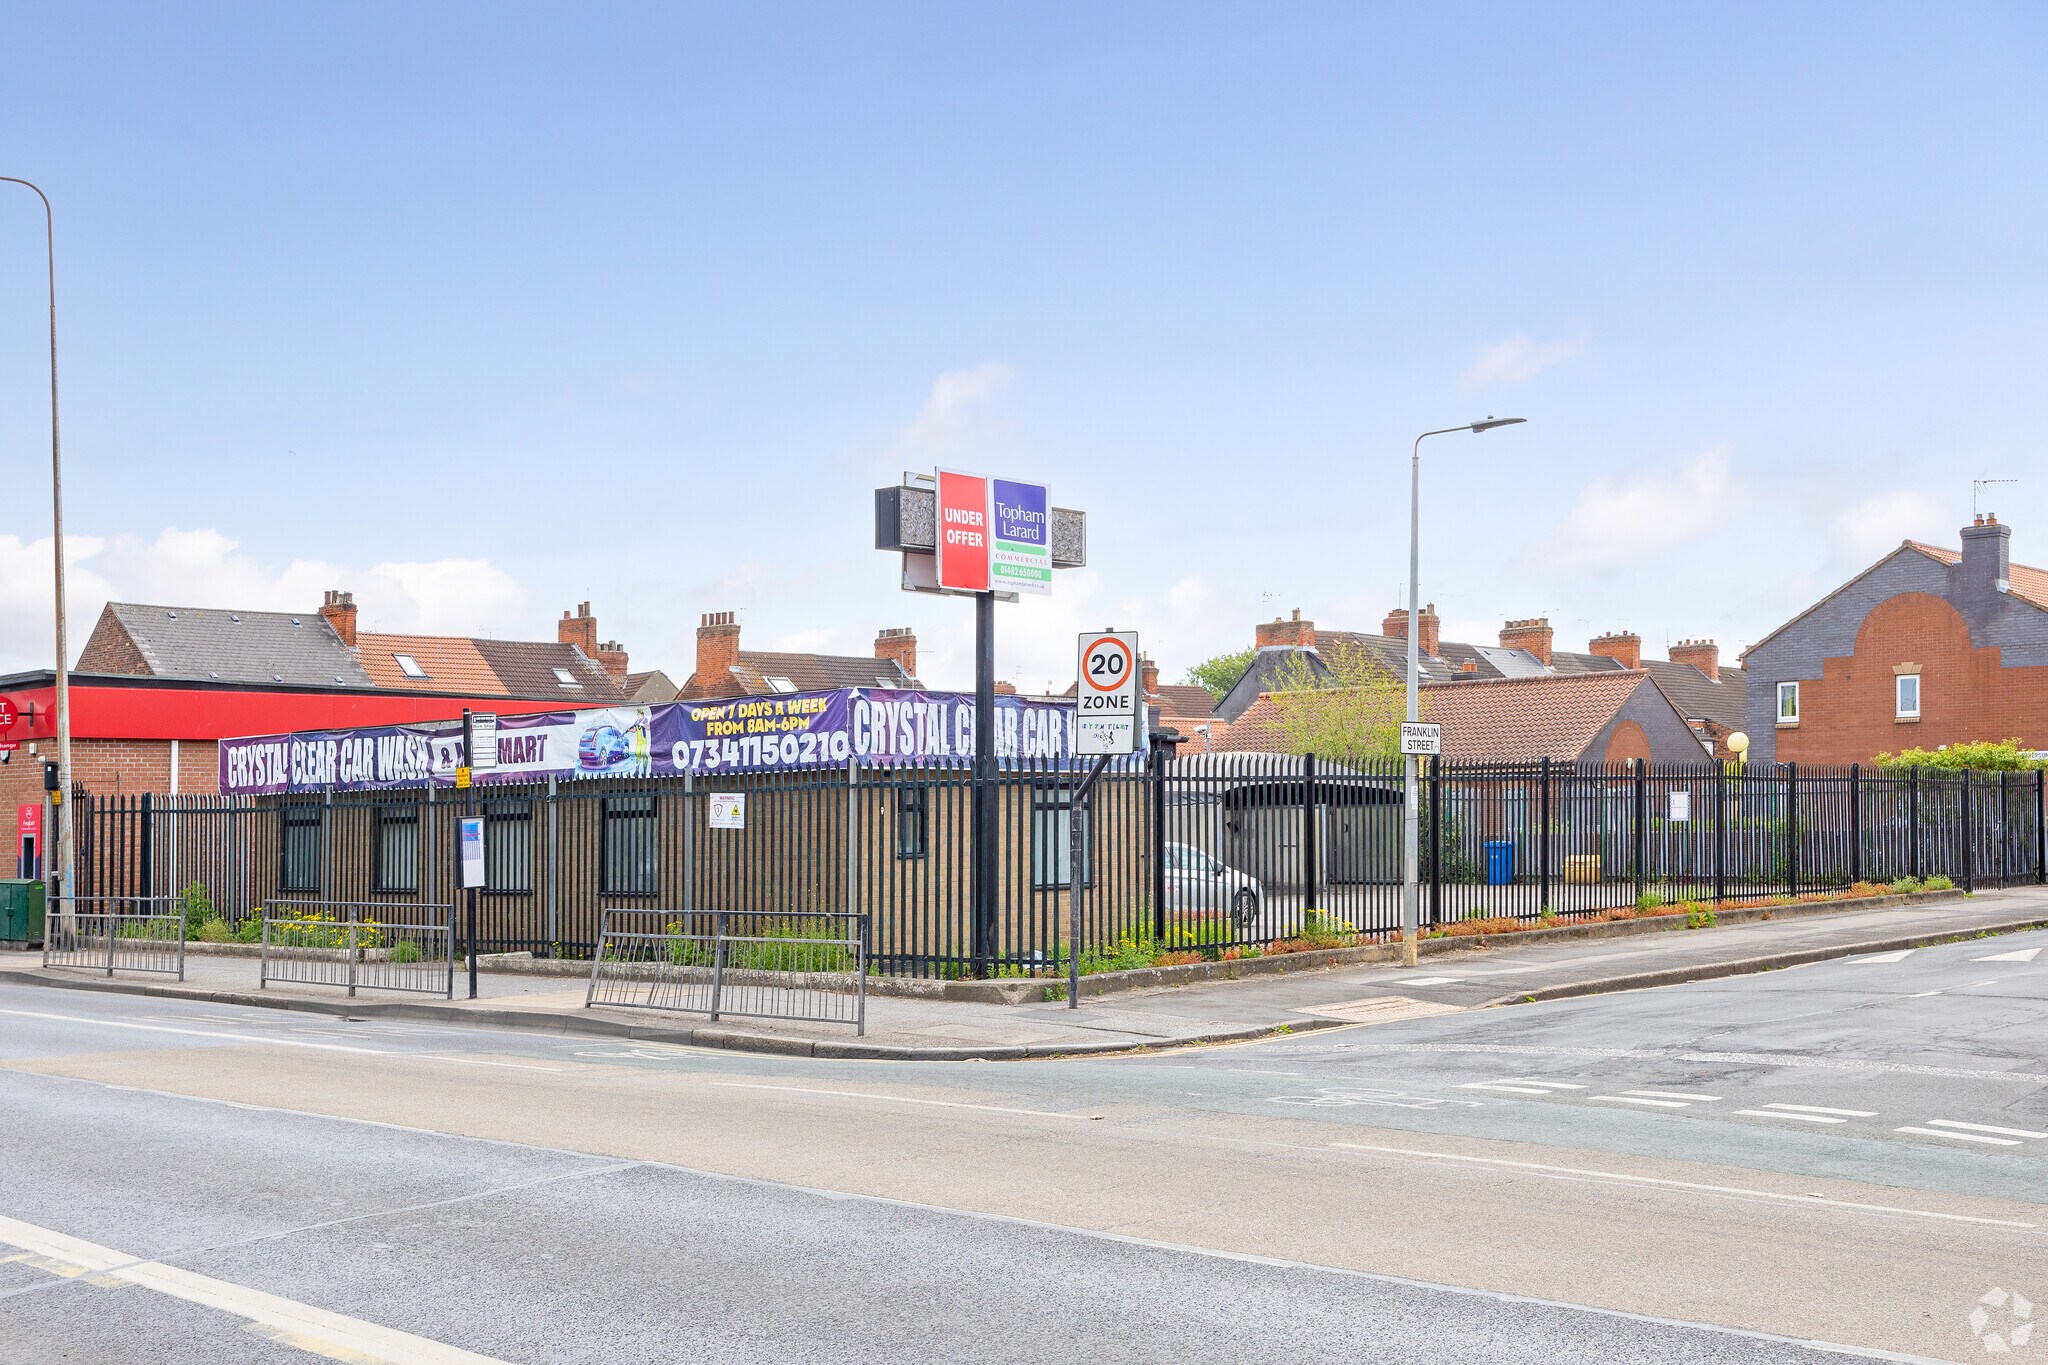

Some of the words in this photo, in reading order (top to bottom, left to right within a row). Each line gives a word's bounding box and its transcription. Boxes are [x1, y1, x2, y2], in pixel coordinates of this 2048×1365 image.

[945, 508, 983, 526] UNDER
[996, 502, 1044, 524] Topham
[947, 529, 983, 547] OFFER
[1003, 521, 1039, 540] Larard
[995, 553, 1048, 566] COMMERCIAL
[1000, 565, 1018, 576] 01482
[1019, 567, 1042, 579] 650000
[1091, 653, 1124, 675] 20
[691, 707, 725, 722] OPEN
[728, 705, 735, 719] 7
[738, 702, 772, 718] DAYS
[775, 702, 785, 715] A
[788, 698, 827, 714] WEEK
[1083, 695, 1129, 709] ZONE
[706, 719, 744, 736] FROM
[747, 716, 810, 733] 8AM-6PM
[854, 699, 950, 756] CRYSTAL
[955, 703, 1018, 758] CLAR
[1022, 707, 1062, 758] CAR
[1403, 726, 1439, 737] FRANKLIN
[672, 731, 850, 769] 07341150210
[1407, 739, 1434, 750] STREET
[228, 742, 289, 788] CRYSTAL
[291, 740, 336, 785] CLEAR
[340, 737, 374, 783] CAR
[378, 735, 430, 781] WASH
[441, 747, 454, 769] &
[498, 733, 548, 765] MART
